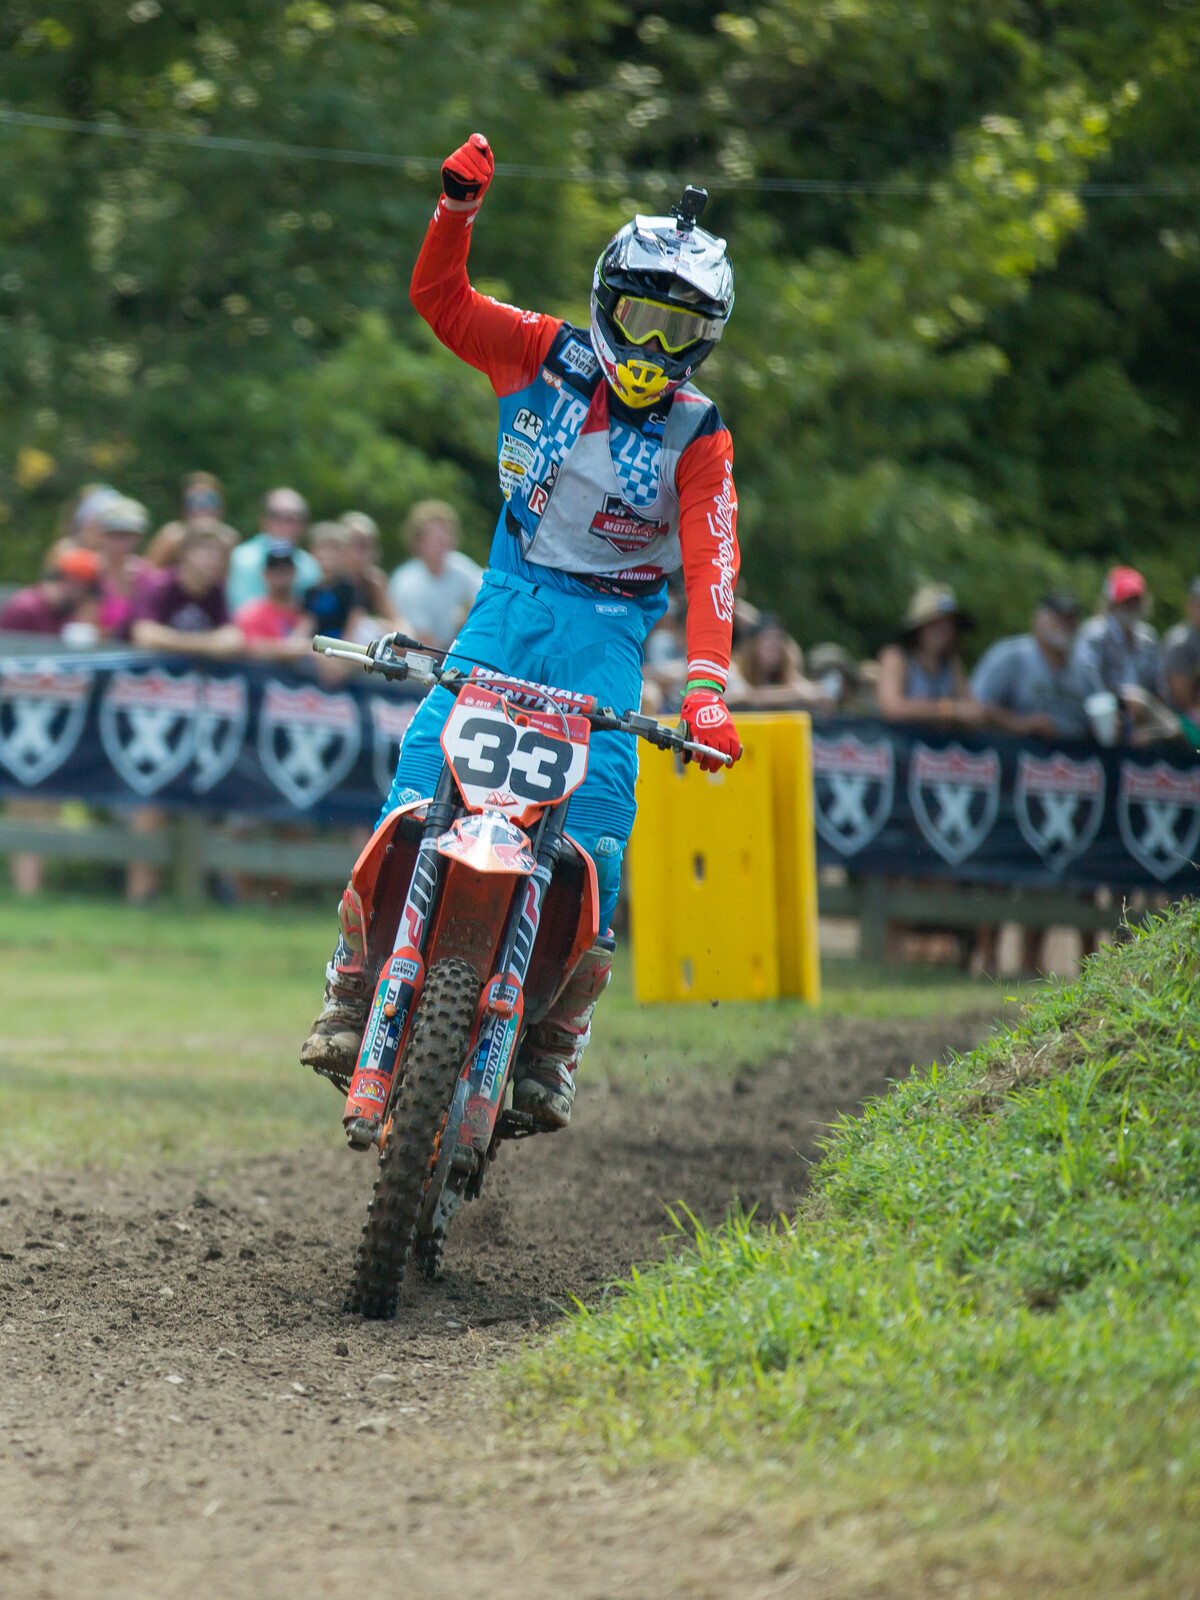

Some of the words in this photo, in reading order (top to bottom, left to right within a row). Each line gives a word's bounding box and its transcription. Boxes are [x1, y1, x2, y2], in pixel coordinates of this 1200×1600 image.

[475, 668, 588, 704] RENTHAL
[452, 716, 574, 801] 33
[372, 987, 397, 1061] DLOP
[499, 1028, 515, 1075] MOTOREX
